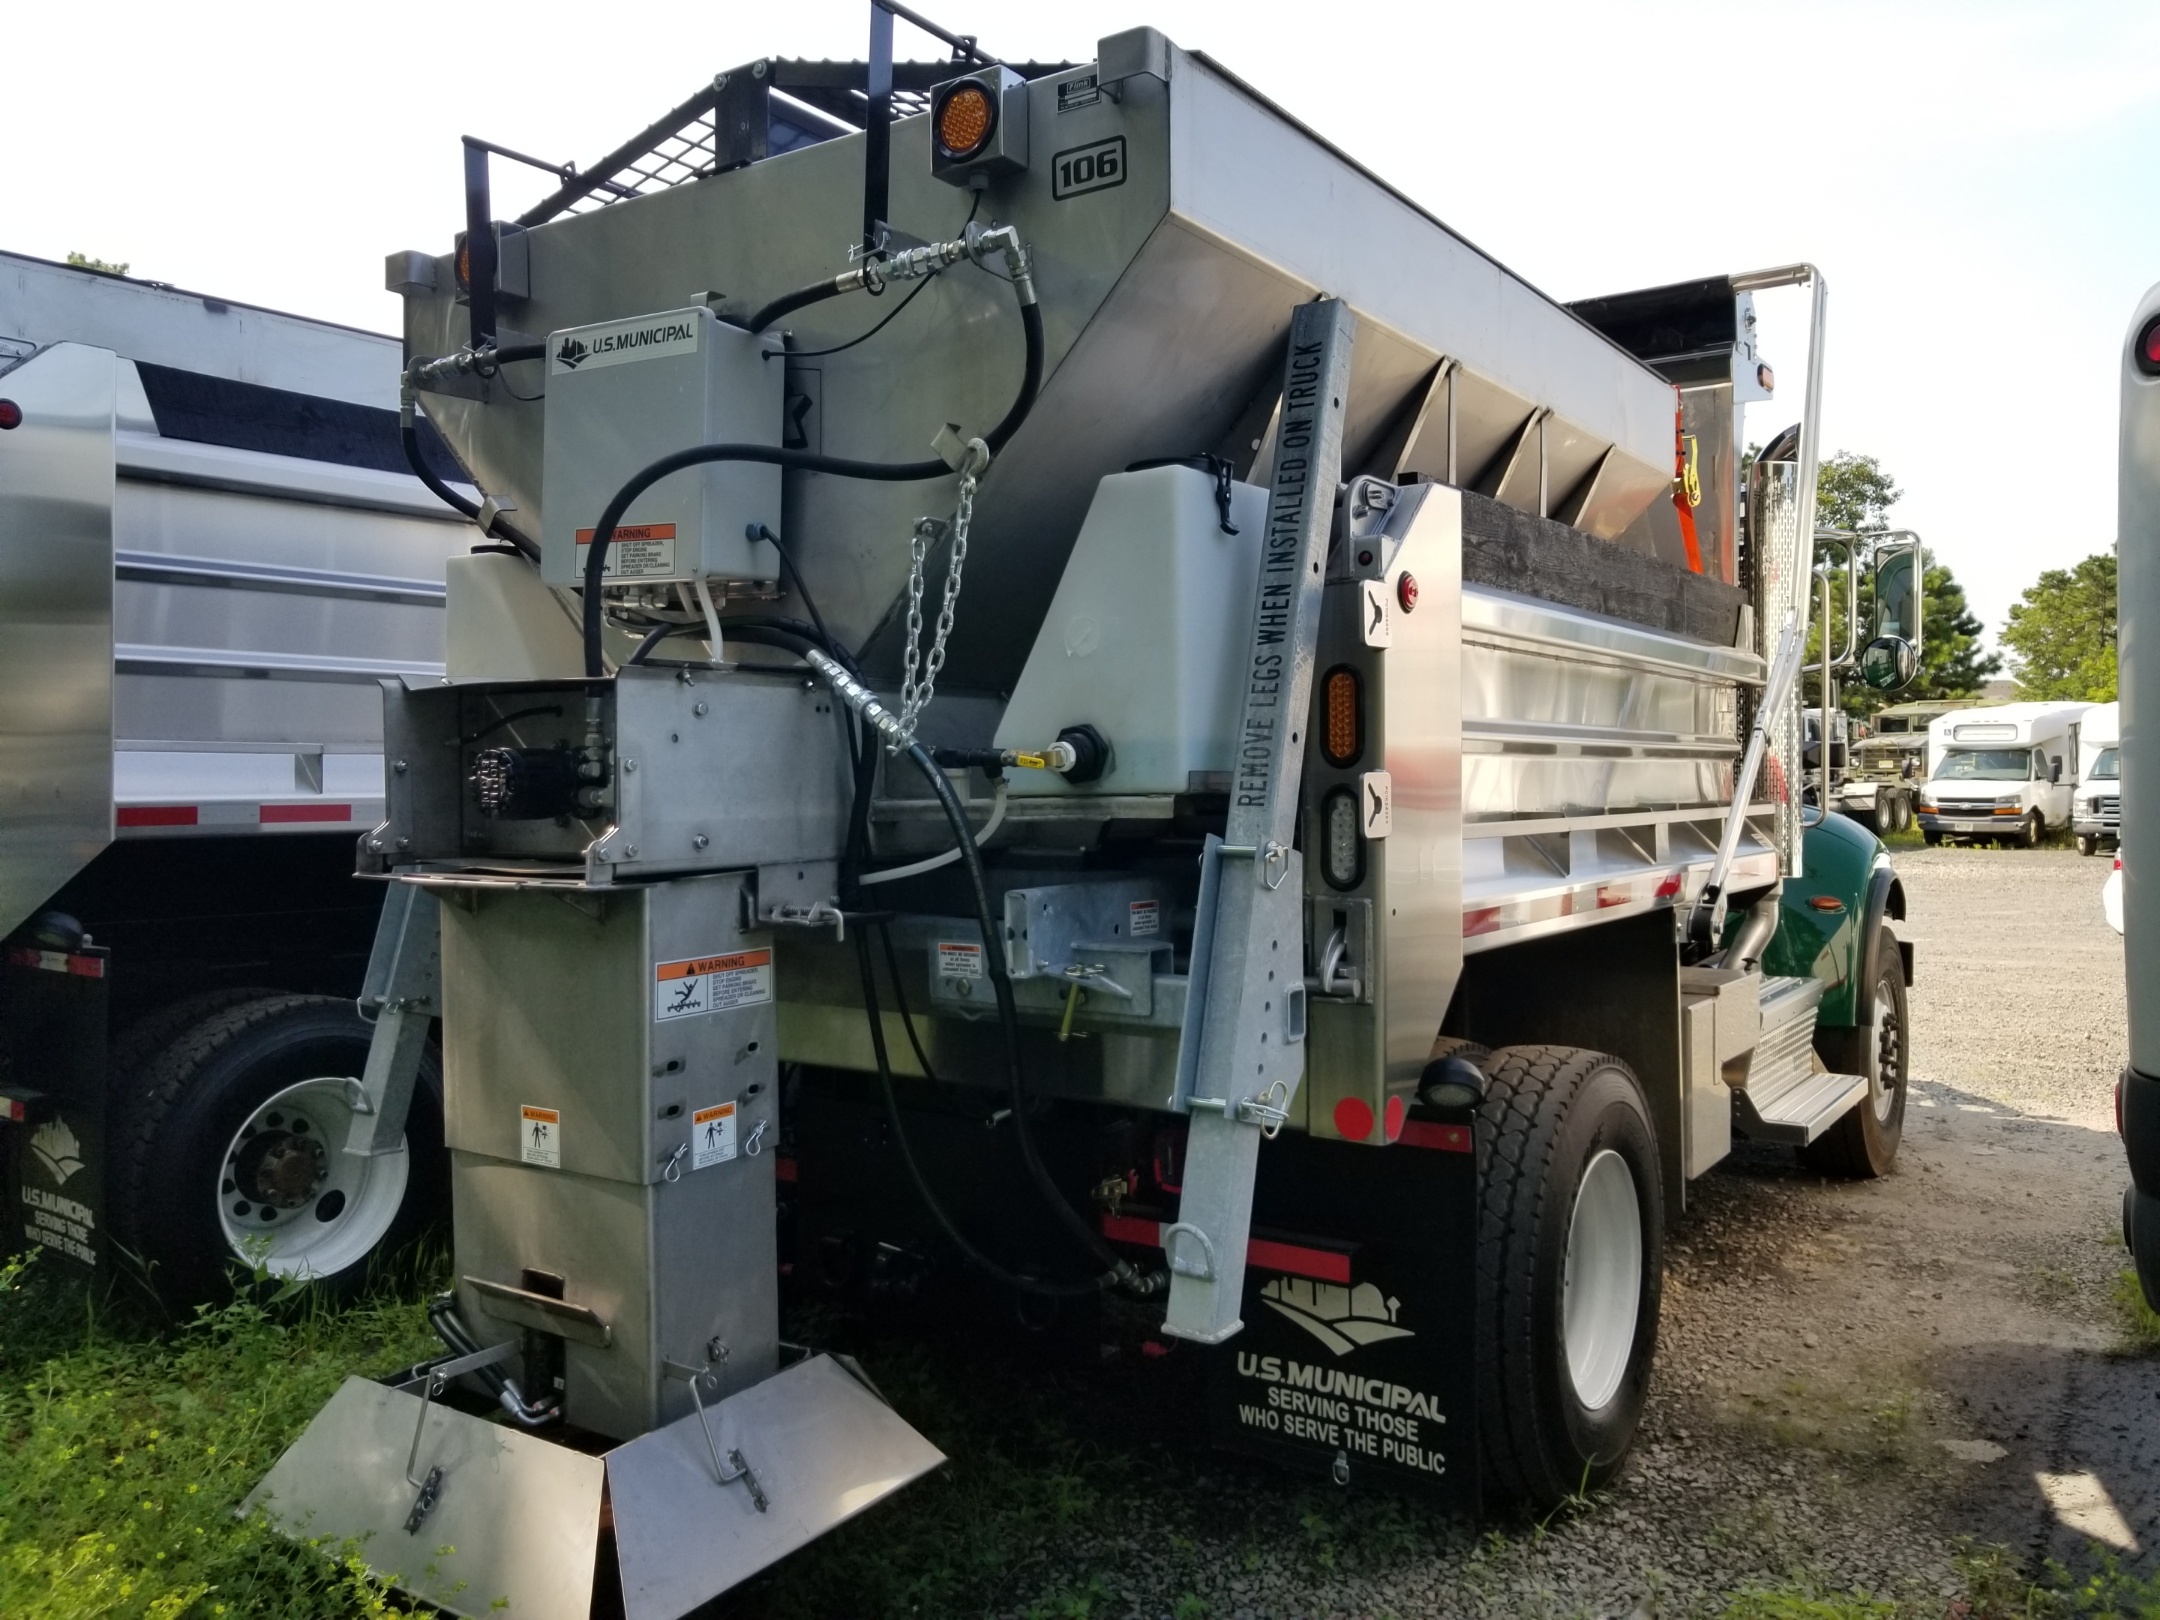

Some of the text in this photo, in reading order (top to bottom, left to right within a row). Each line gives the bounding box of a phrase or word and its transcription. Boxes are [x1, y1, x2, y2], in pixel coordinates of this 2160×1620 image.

[1060, 148, 1118, 188] 106
[1237, 341, 1323, 807] REMOVE LEGS WHEN INSTALLED ON TRUCK
[698, 956, 745, 972] WARNING
[703, 1106, 733, 1119] WARNING
[1268, 1386, 1419, 1442] SERVING THOSE
[1239, 1404, 1445, 1474] WHO SERVE THE PUBLIC
